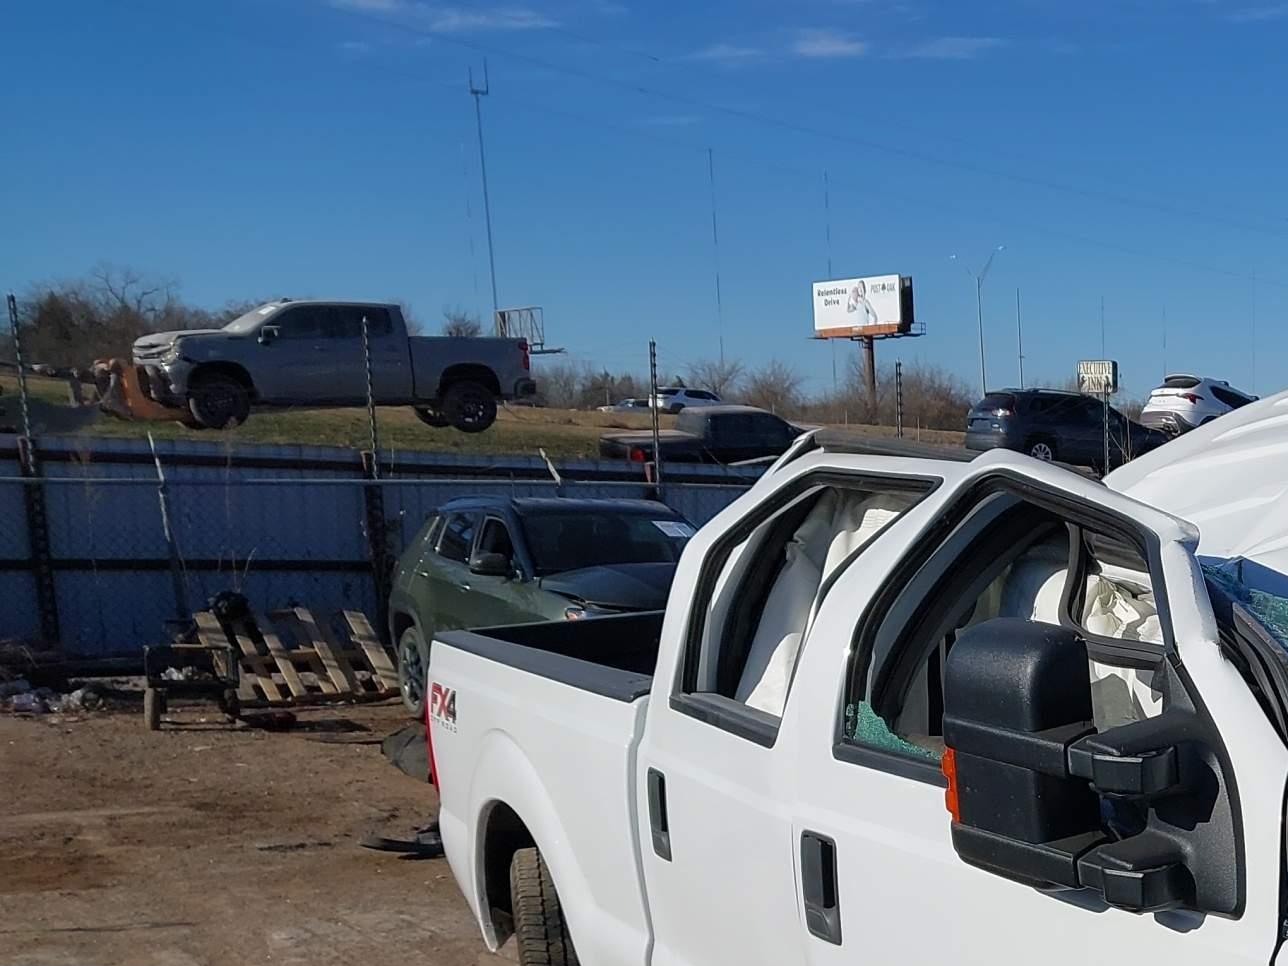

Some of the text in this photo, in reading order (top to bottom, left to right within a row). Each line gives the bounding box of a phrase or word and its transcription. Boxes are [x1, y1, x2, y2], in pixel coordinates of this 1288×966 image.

[817, 287, 847, 297] Relentless
[824, 298, 840, 307] Drive
[1087, 375, 1103, 391] INN
[431, 682, 457, 723] FX4
